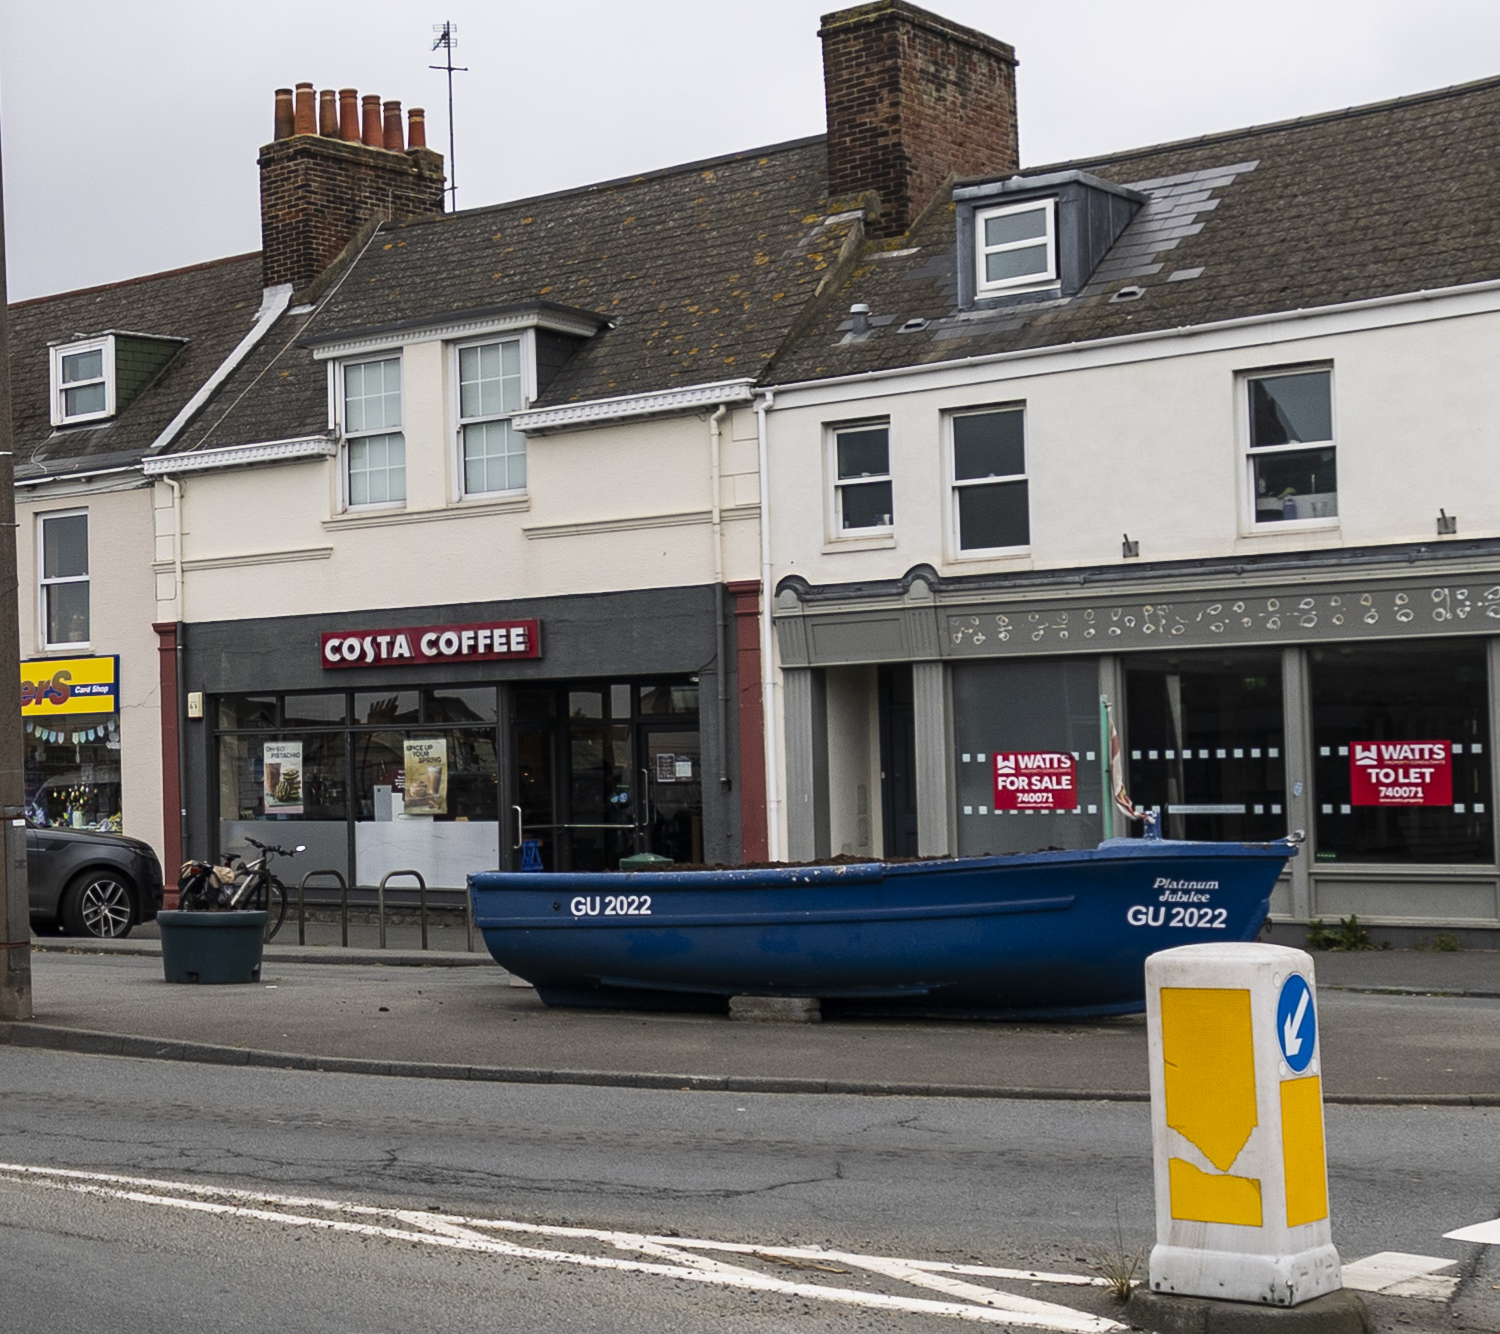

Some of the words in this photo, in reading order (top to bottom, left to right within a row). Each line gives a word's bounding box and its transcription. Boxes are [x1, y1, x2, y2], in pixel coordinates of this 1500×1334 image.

[324, 634, 413, 663] COSTA
[420, 627, 527, 656] COFFEE
[75, 685, 91, 694] Card
[92, 684, 109, 694] Shop
[1380, 744, 1446, 759] WATTS
[1017, 753, 1072, 769] WATTS
[997, 775, 1029, 790] FOR
[1031, 775, 1073, 789] SALE
[1366, 768, 1395, 784] TO
[1398, 768, 1435, 784] LET
[1016, 792, 1054, 803] 740071
[1378, 786, 1424, 797] 740071
[1153, 877, 1219, 889] Platinum
[1159, 890, 1211, 902] Jubilee
[570, 896, 600, 916] GU
[604, 895, 652, 915] 2022
[1127, 905, 1166, 926] GU
[1169, 907, 1228, 928] 2022
